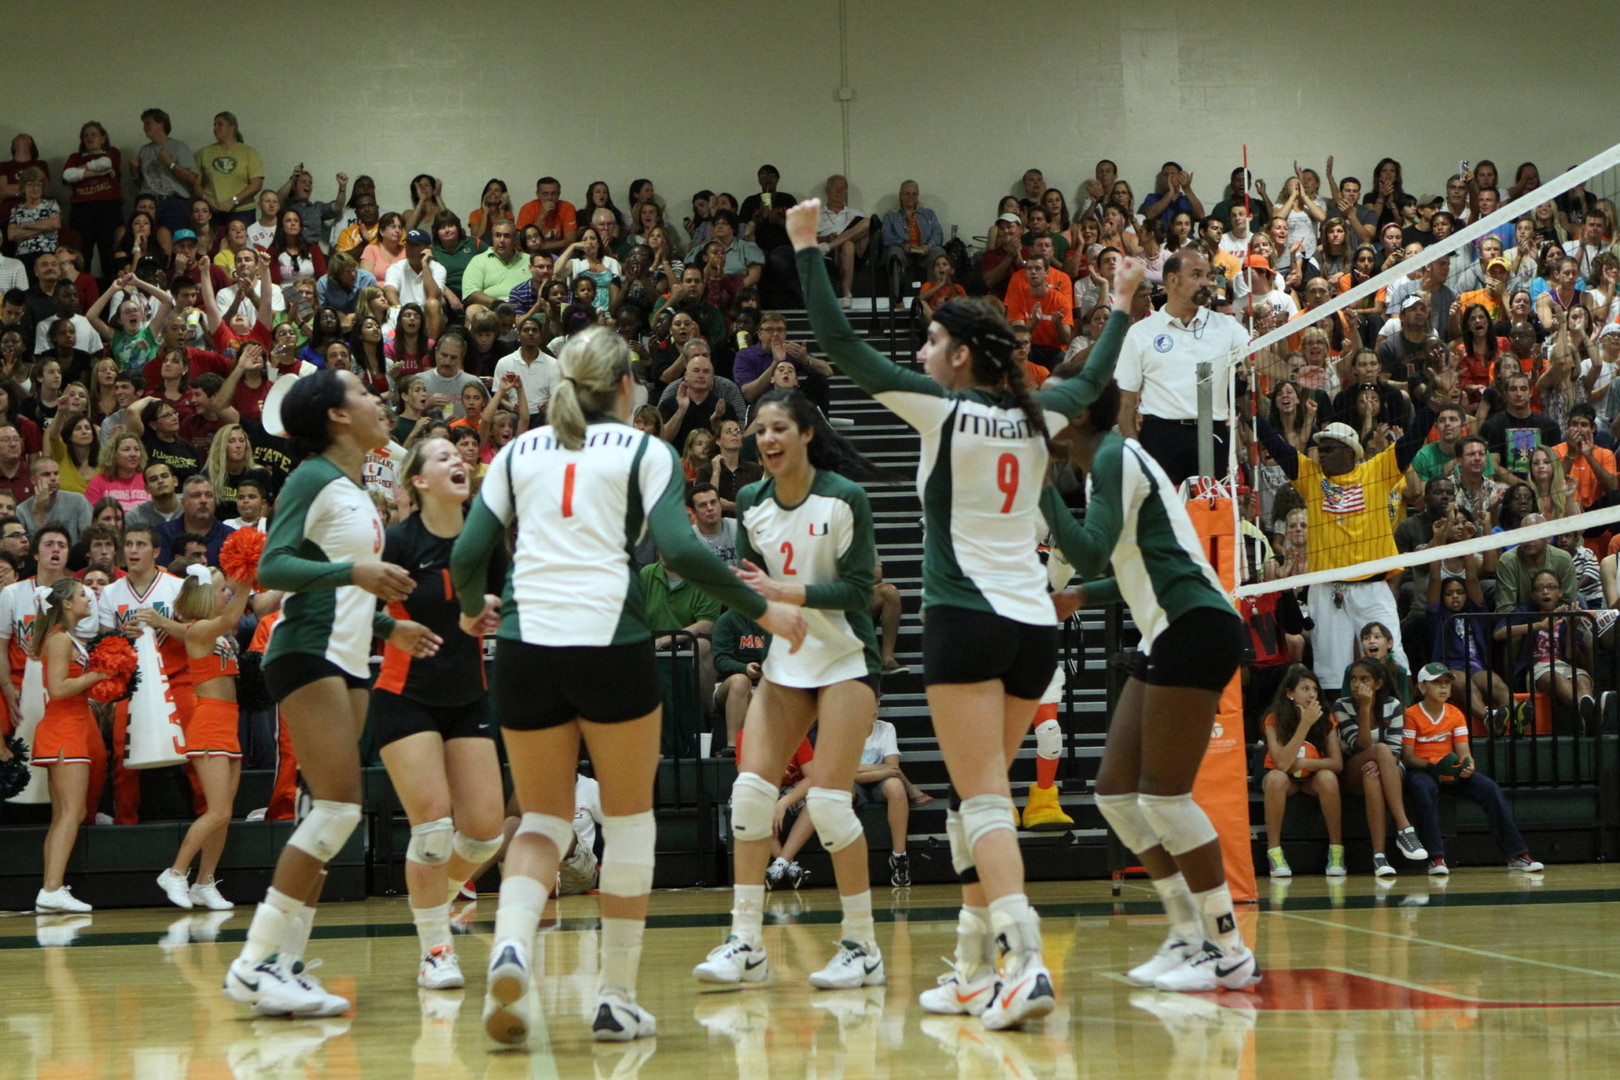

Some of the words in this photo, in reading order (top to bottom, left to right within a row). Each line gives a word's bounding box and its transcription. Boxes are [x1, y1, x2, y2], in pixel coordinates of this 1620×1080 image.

[253, 446, 292, 473] STATE
[561, 463, 576, 518] 1
[997, 452, 1019, 514] 9
[780, 542, 797, 575] 2
